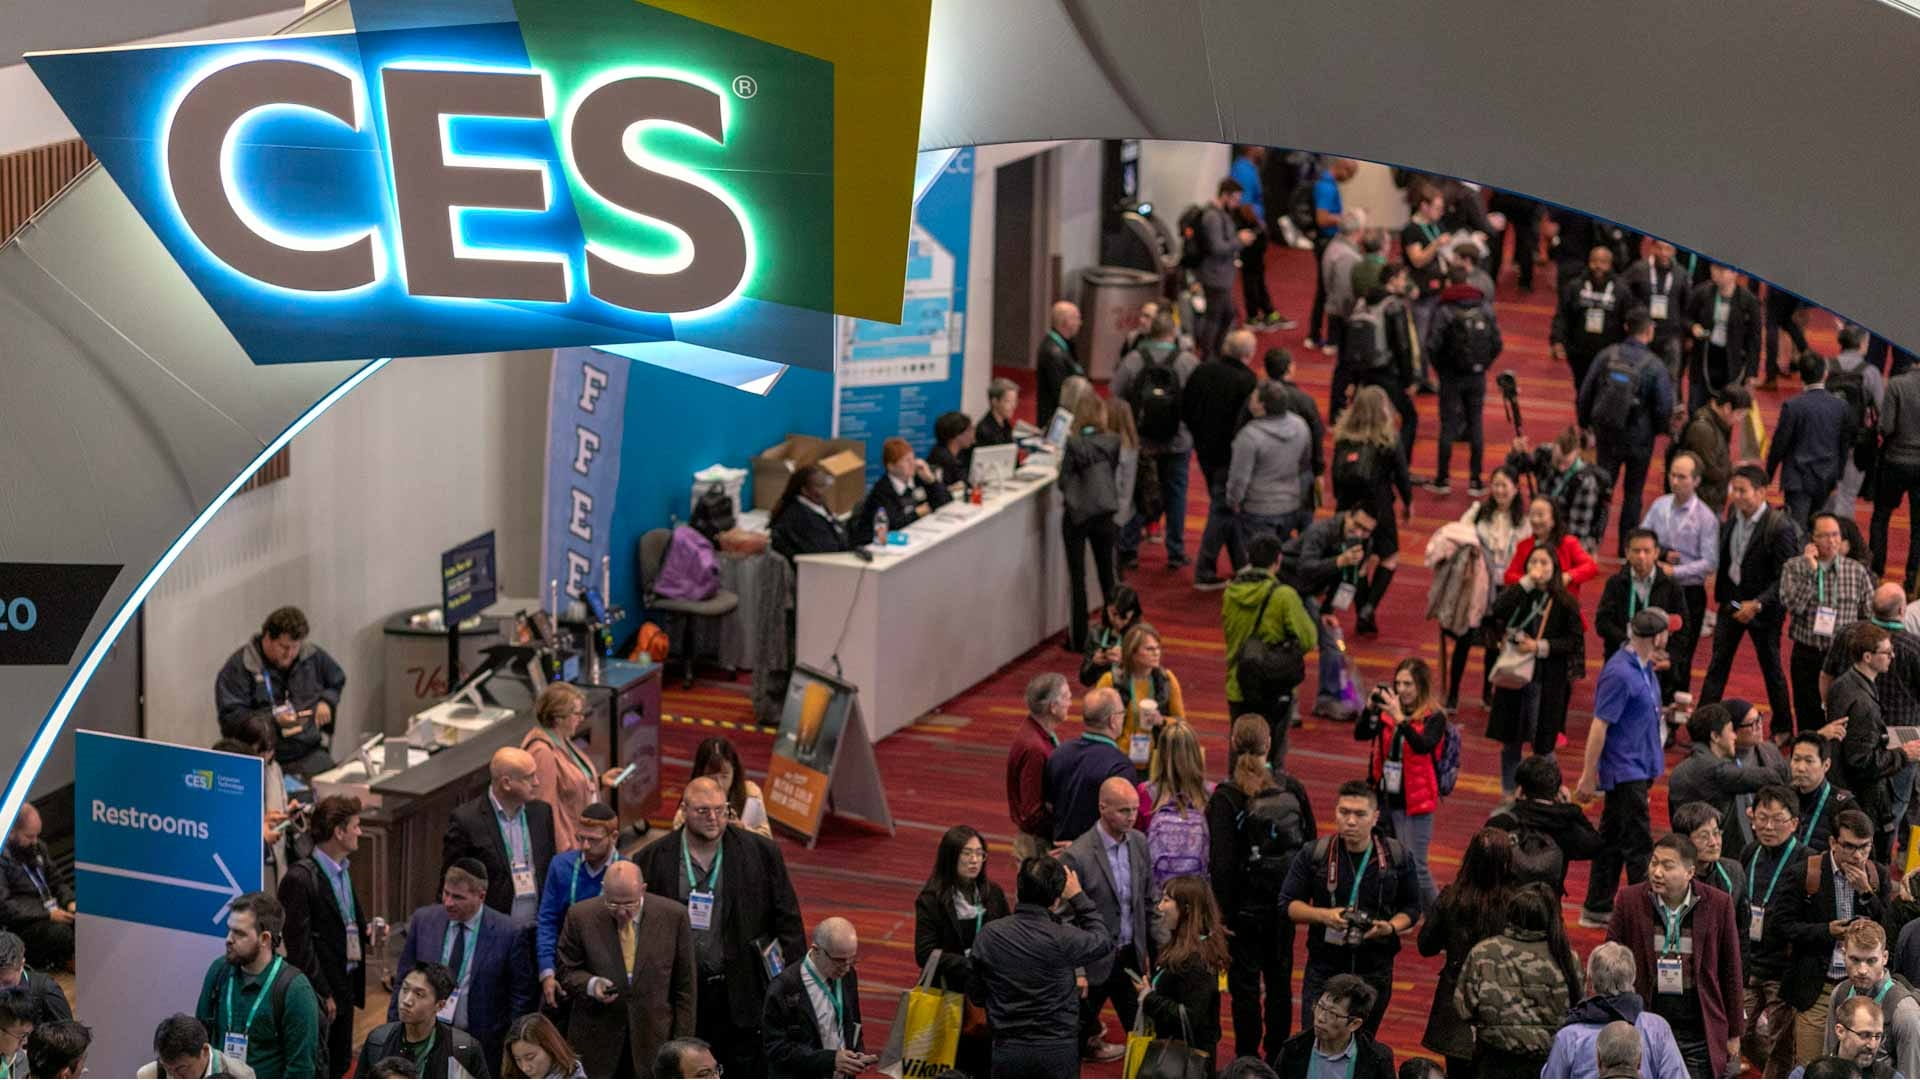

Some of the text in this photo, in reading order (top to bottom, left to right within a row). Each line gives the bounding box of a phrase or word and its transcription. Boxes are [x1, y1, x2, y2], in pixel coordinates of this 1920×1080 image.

[166, 58, 748, 314] CES
[184, 773, 208, 790] CES
[92, 799, 209, 840] Restrooms
